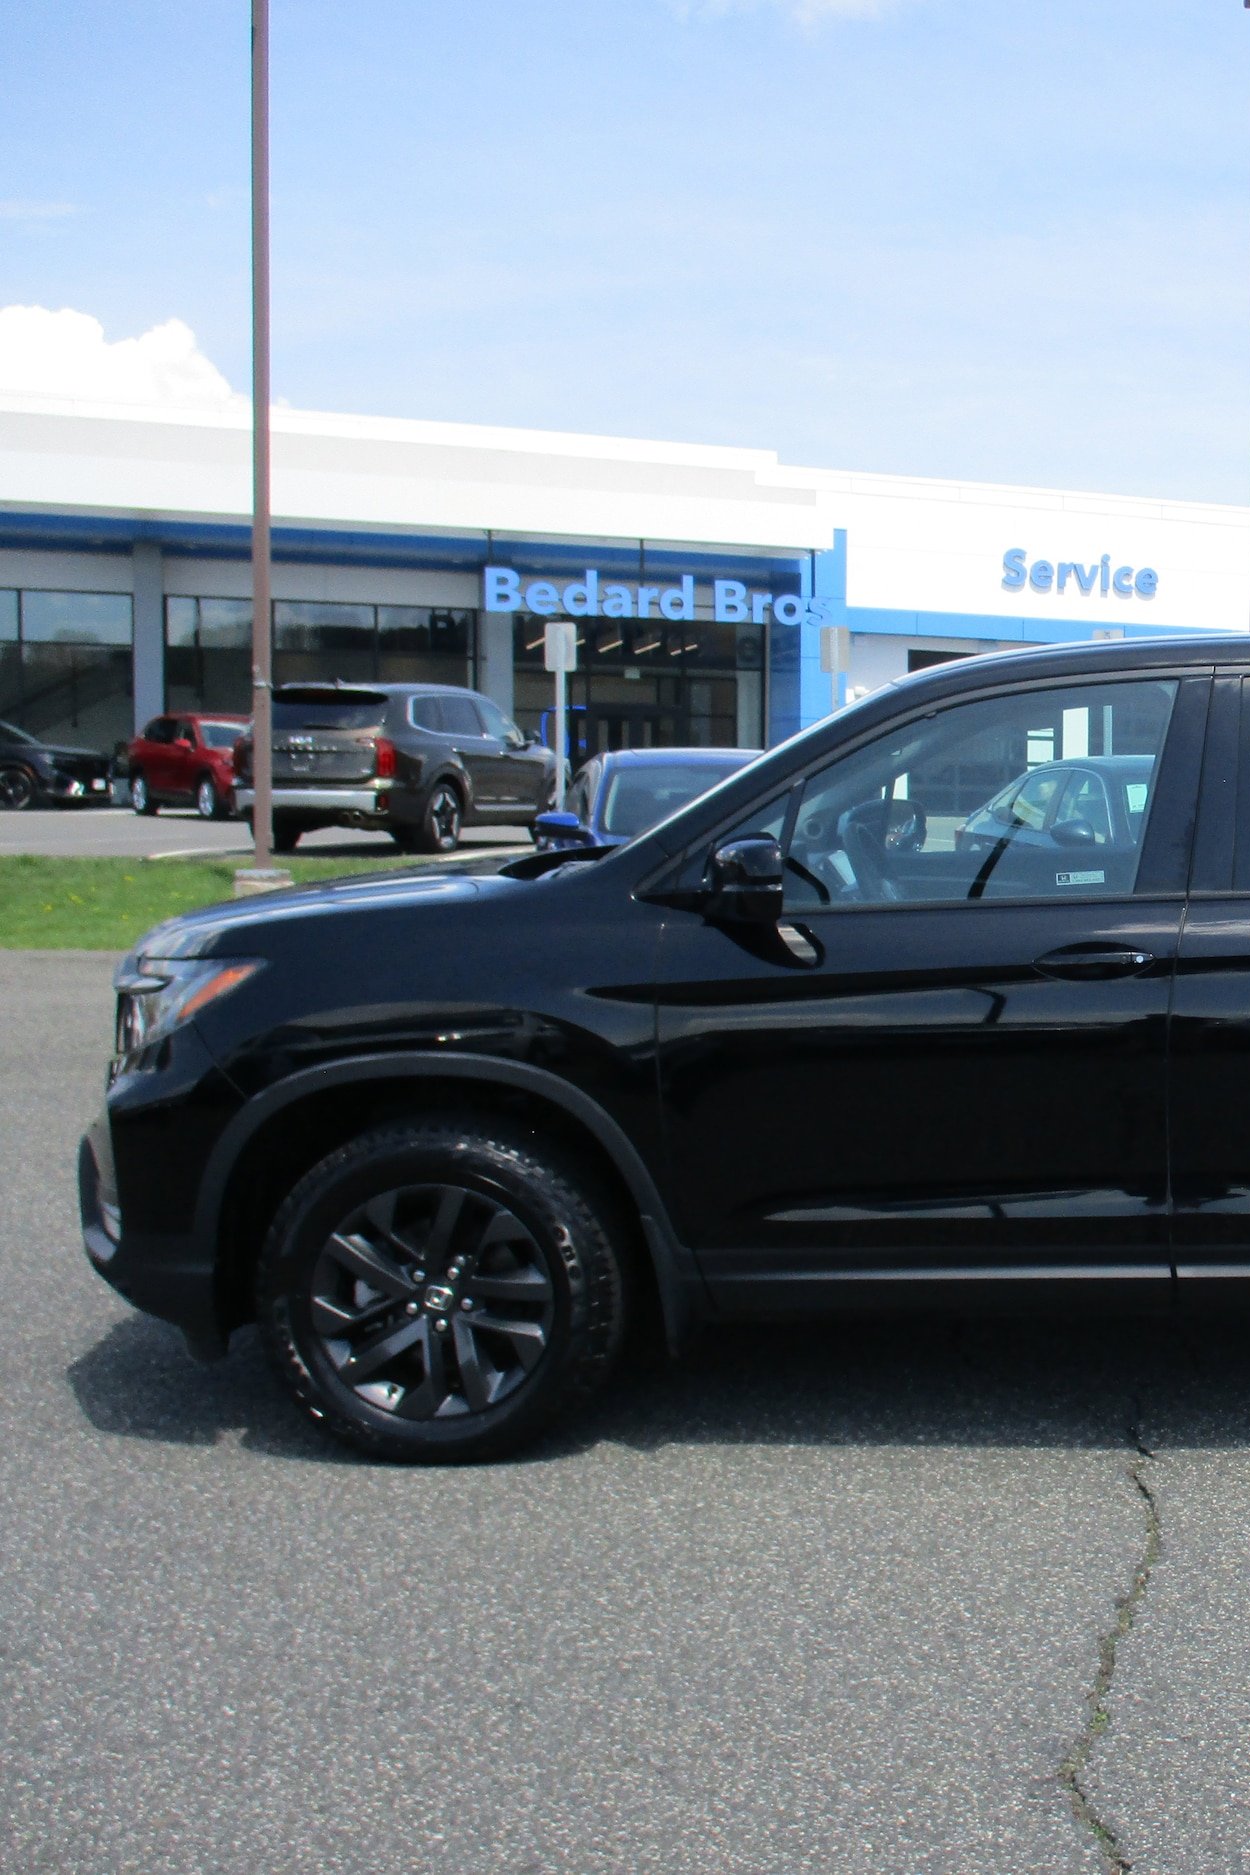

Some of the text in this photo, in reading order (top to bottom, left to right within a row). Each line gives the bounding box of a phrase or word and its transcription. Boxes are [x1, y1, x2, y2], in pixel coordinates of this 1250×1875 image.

[484, 566, 833, 626] Bedard Bros
[1001, 547, 1159, 597] Service
